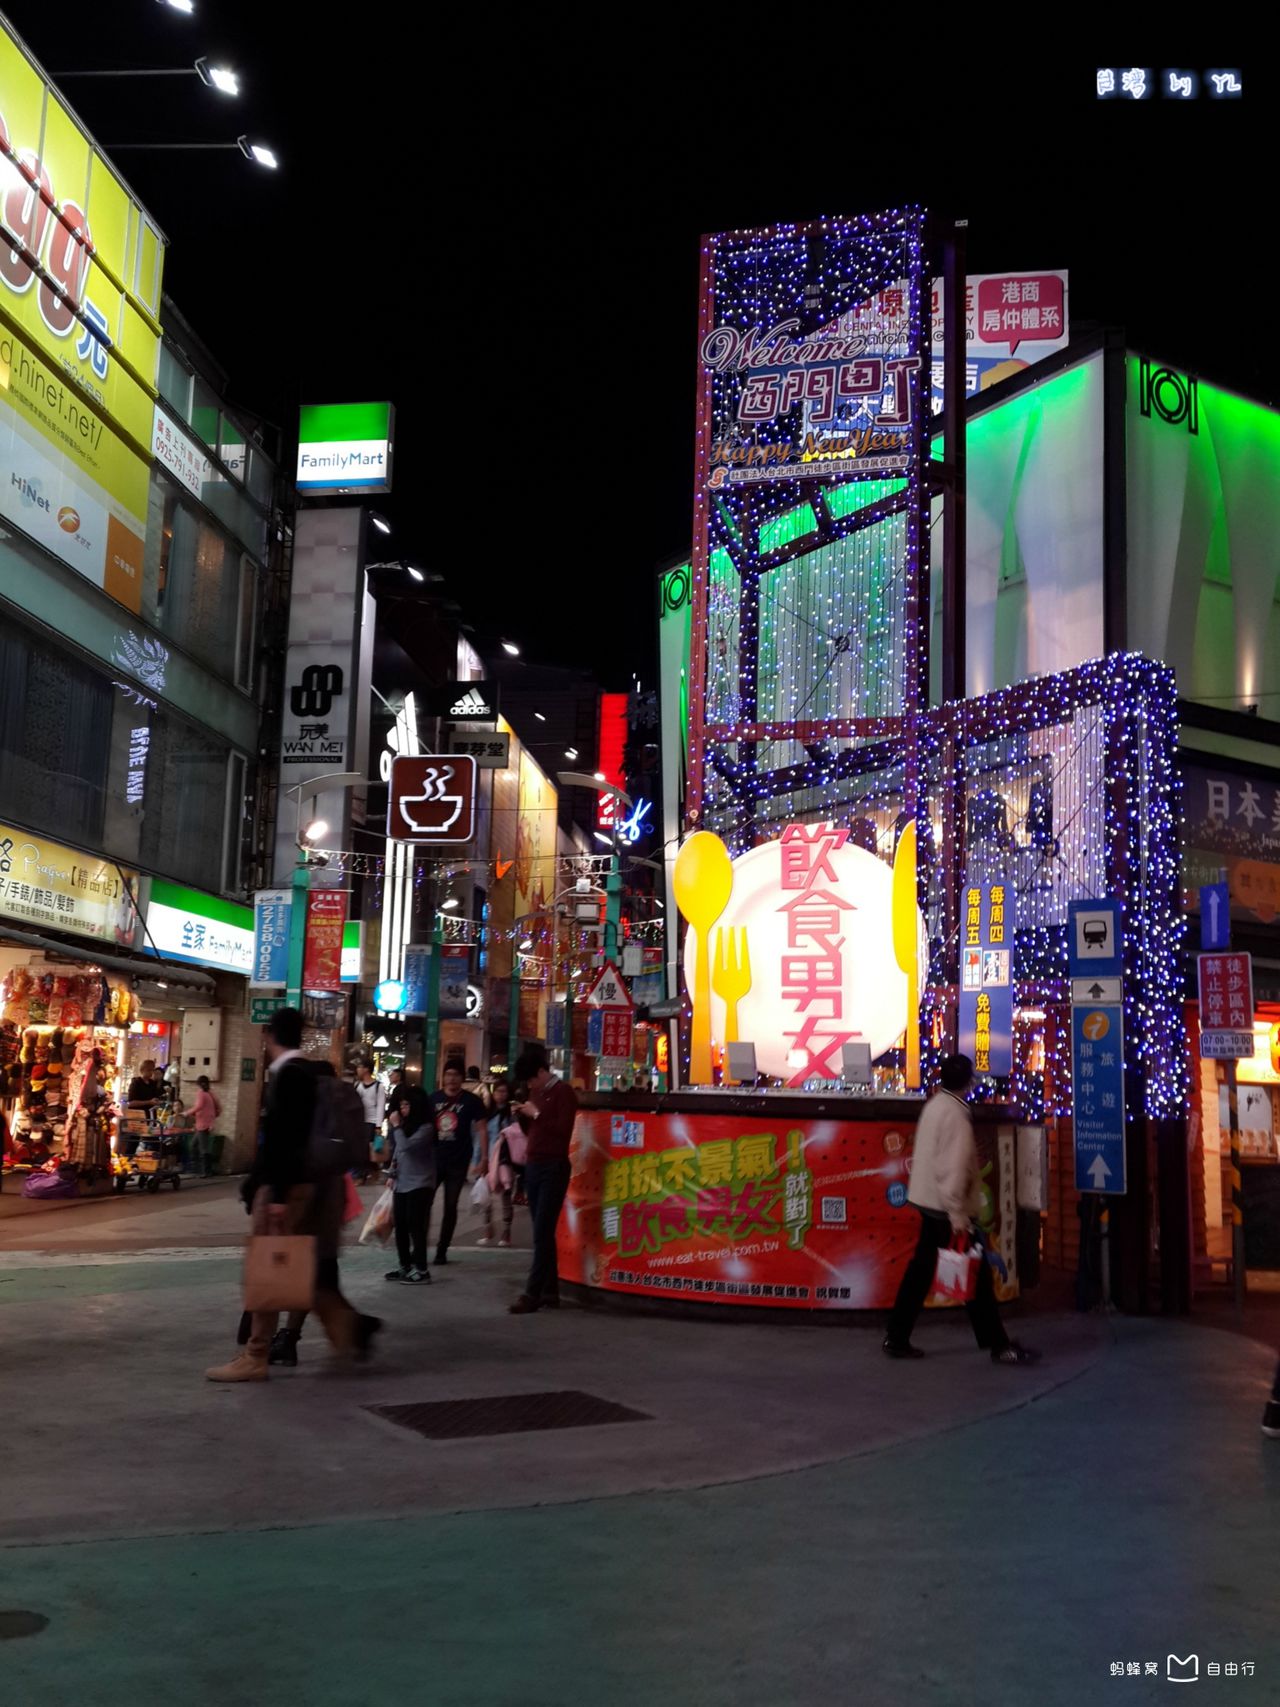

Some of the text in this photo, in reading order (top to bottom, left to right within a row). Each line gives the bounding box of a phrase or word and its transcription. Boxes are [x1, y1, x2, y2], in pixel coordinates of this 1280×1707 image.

[1001, 281, 1039, 303] 港商
[982, 306, 1060, 331] 房仲體系
[701, 318, 868, 372] Welcome
[737, 357, 922, 426] 西門町
[301, 452, 383, 470] FamilyMart
[708, 425, 912, 466] Happy New Year
[11, 472, 51, 513] HiNet
[449, 704, 491, 715] adidas
[283, 742, 344, 754] WAN MEI
[966, 887, 982, 945] 每周五
[990, 885, 1005, 944] 每周四
[181, 921, 207, 950] 全家
[775, 823, 863, 1087] 飲食男女
[598, 982, 618, 1001] 慢
[975, 992, 991, 1073] 免費贈送
[1077, 1120, 1105, 1129] Visitor
[1077, 1130, 1123, 1142] Information
[1077, 1140, 1106, 1152] Center
[603, 1183, 781, 1251] 看 飲食男女
[785, 1173, 809, 1245] 就對了
